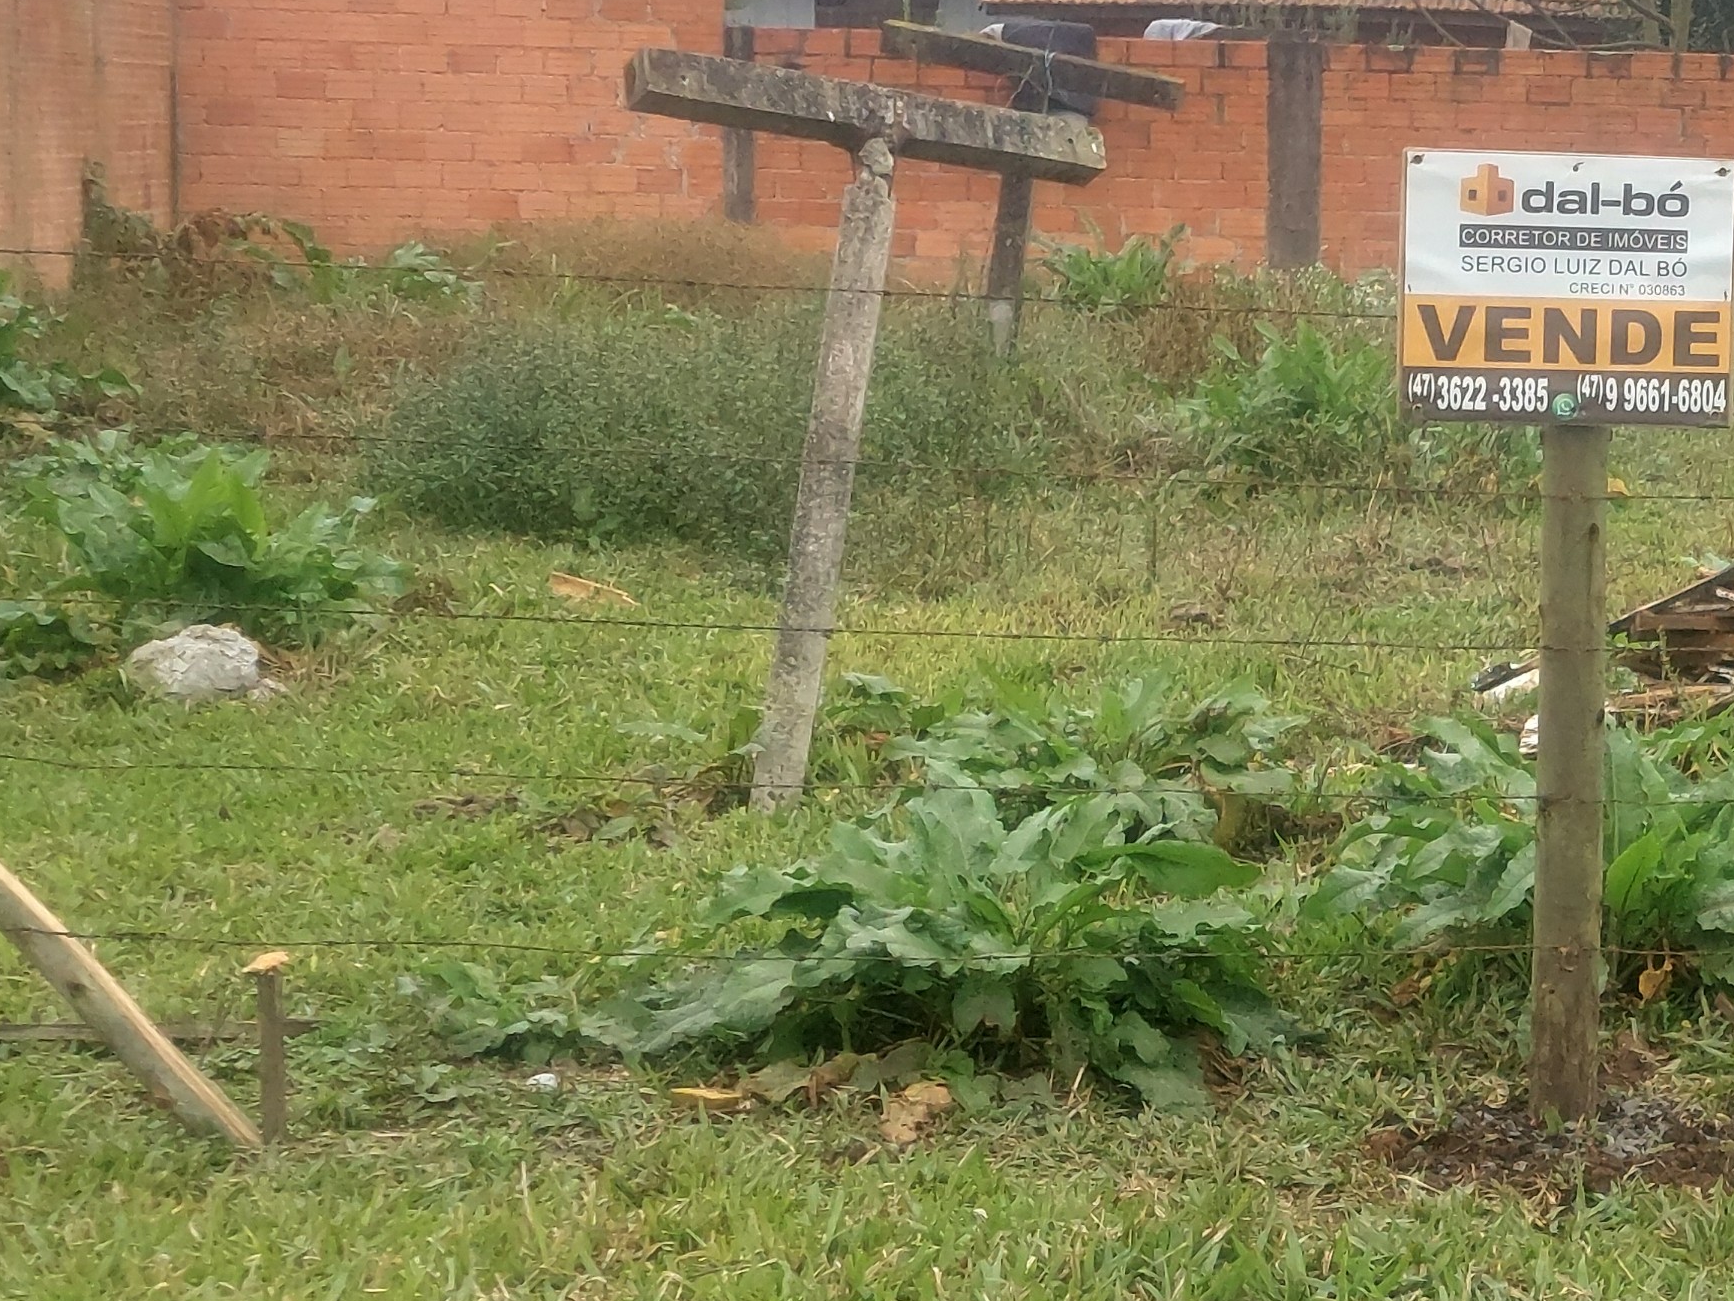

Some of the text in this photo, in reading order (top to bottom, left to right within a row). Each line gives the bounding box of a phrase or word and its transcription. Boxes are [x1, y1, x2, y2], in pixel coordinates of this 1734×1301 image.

[1461, 228, 1687, 250] CORRETOR DE IMÓVEIS
[1461, 255, 1688, 278] SERGIO LUIZ DAL BÓ
[1569, 282, 1615, 295] CRECI
[1638, 284, 1686, 297] 030863
[1417, 303, 1721, 368] VENDE
[1623, 378, 1727, 413] 9661-6804
